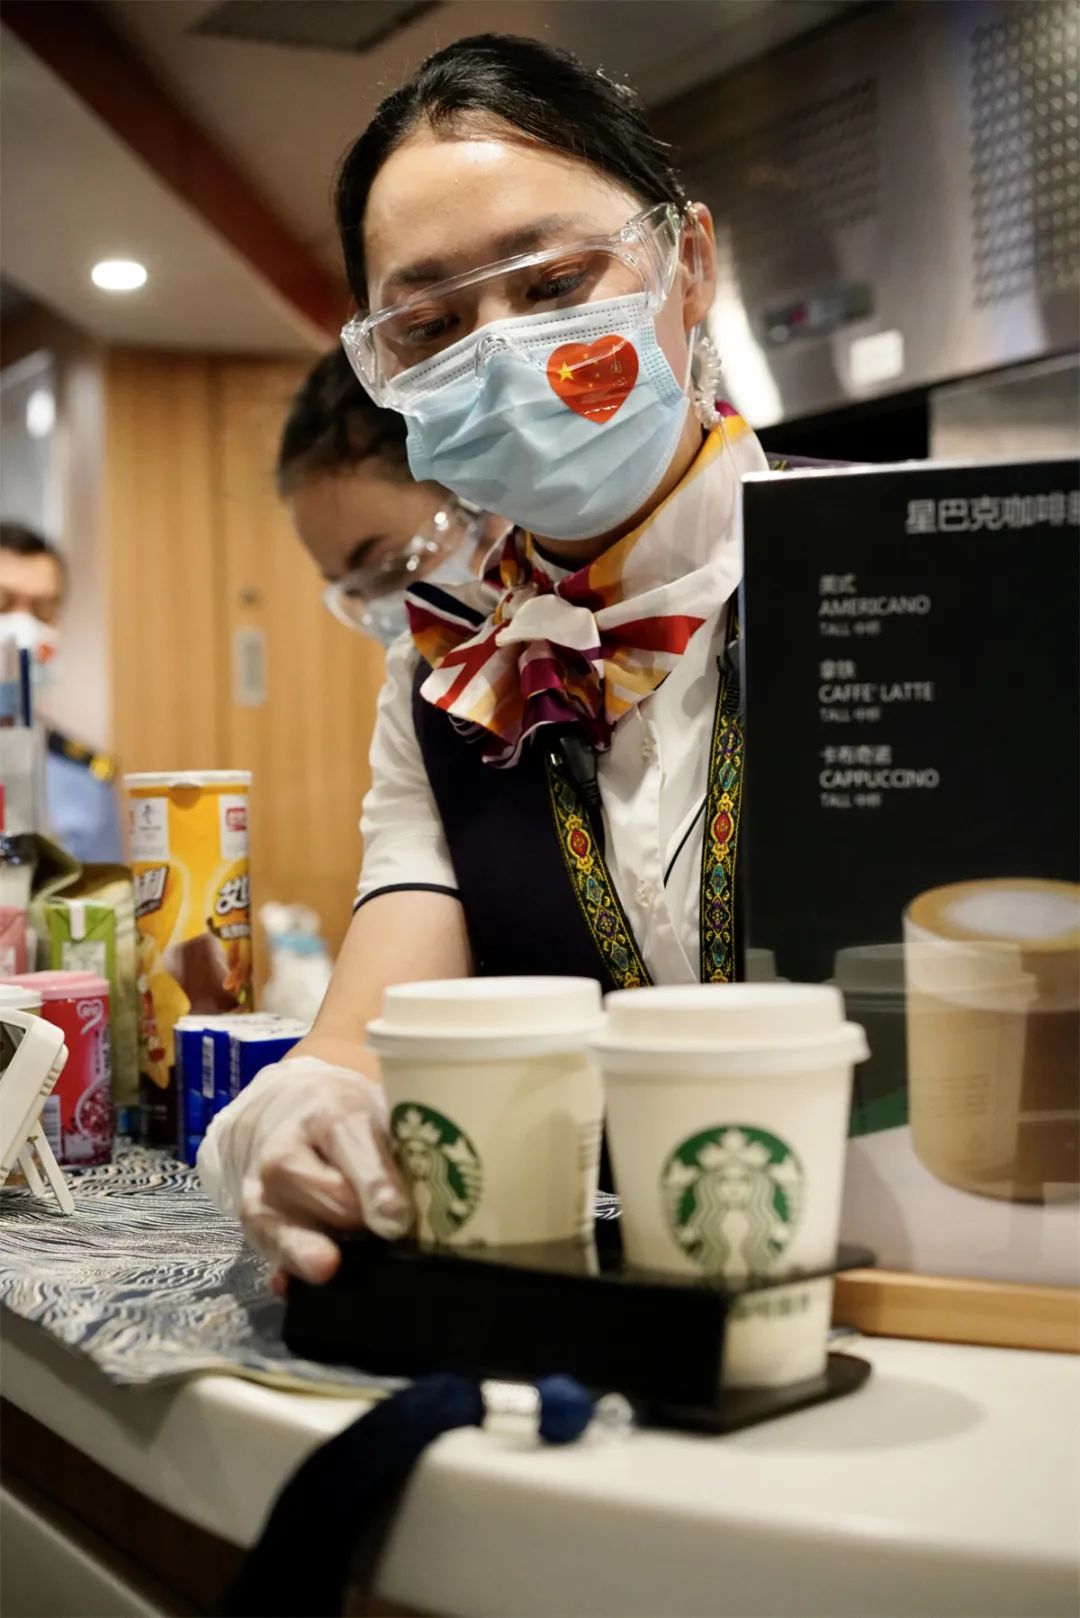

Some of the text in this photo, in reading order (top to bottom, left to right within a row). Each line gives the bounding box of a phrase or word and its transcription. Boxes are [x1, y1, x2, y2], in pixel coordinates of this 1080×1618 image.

[818, 595, 931, 616] AMERICANO
[880, 681, 934, 703] LATTE
[818, 768, 940, 788] CAPPUCCINO
